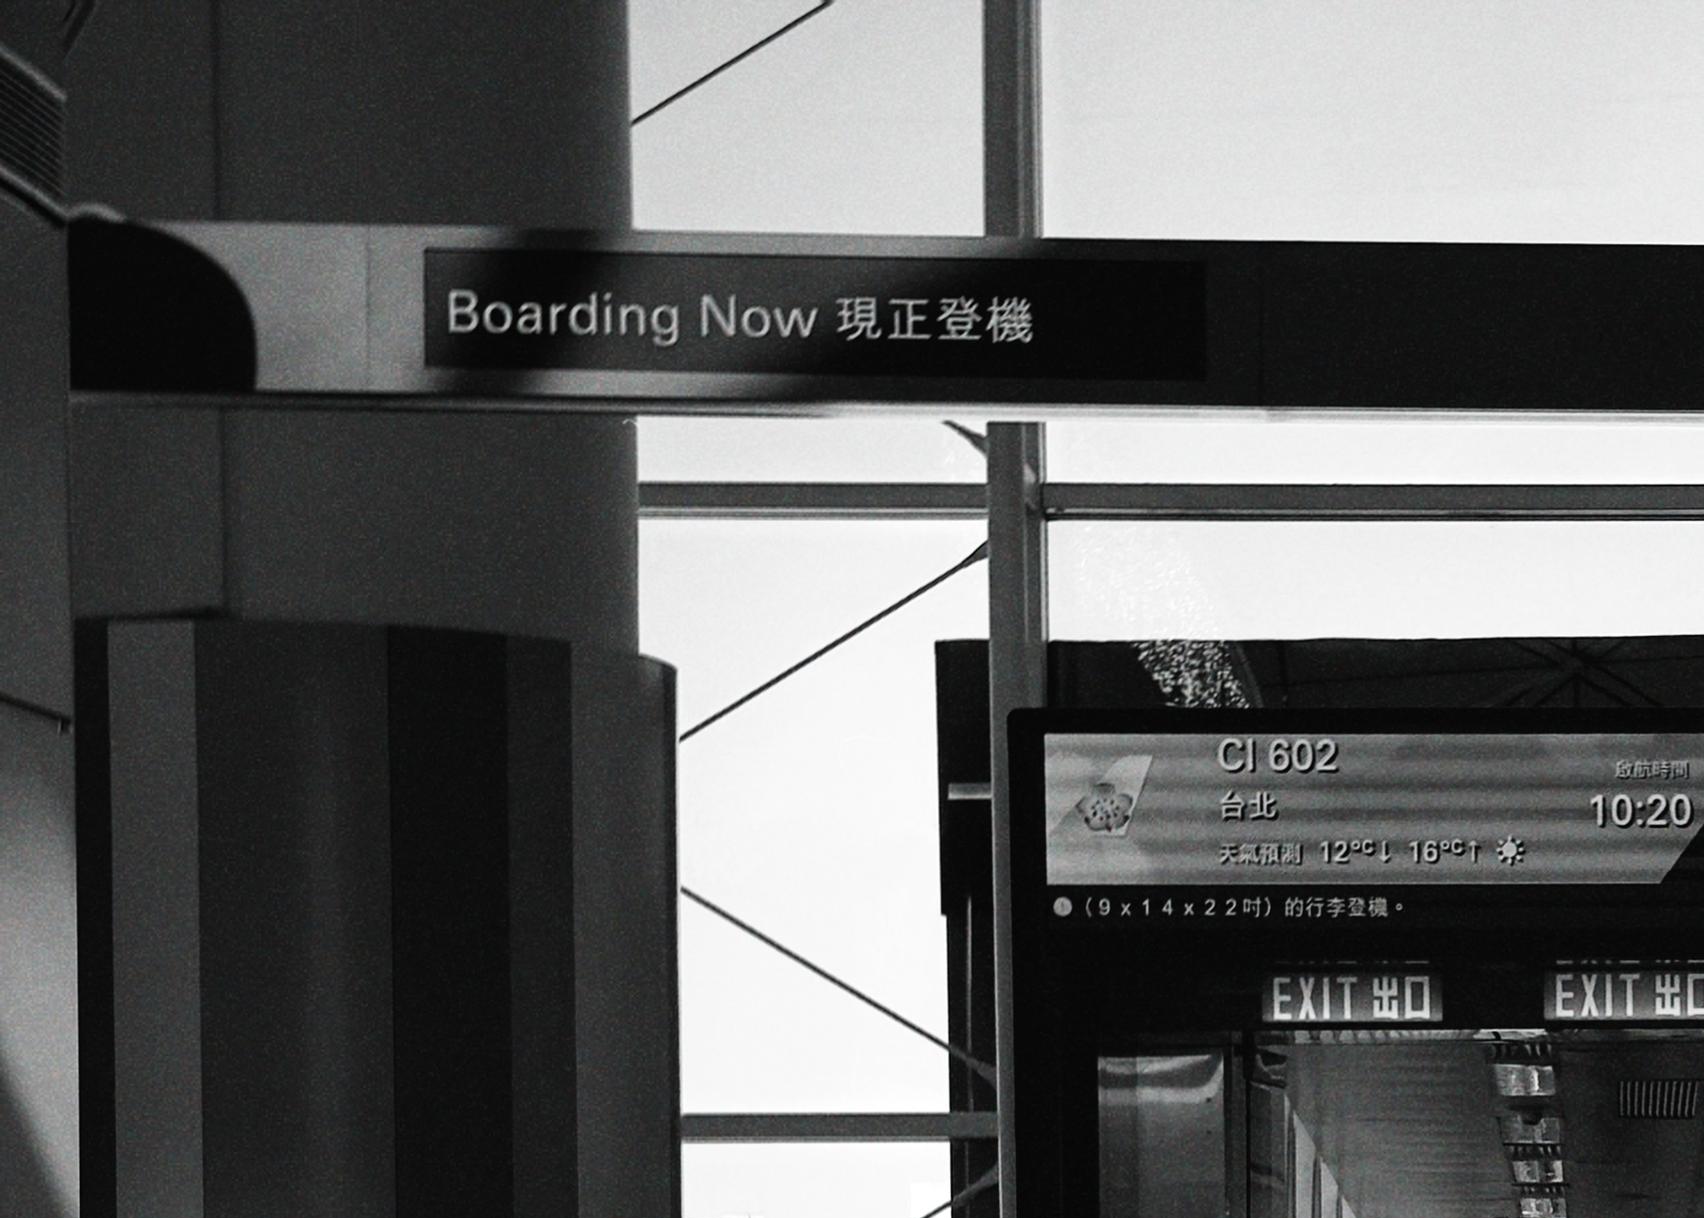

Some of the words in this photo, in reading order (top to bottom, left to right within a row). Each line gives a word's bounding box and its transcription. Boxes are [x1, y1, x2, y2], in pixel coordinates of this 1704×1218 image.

[447, 288, 679, 346] Boarding
[699, 290, 818, 337] Now
[837, 296, 1033, 343] 現正登機
[1217, 738, 1254, 772] CI
[1269, 738, 1339, 772] 602
[1219, 790, 1278, 821] 台北
[1590, 793, 1692, 827] 10:20
[1219, 842, 1303, 865] 天氣預測
[1273, 976, 1358, 1020] EXIT
[1373, 976, 1431, 1020] 出口
[1556, 973, 1641, 1017] EXIT
